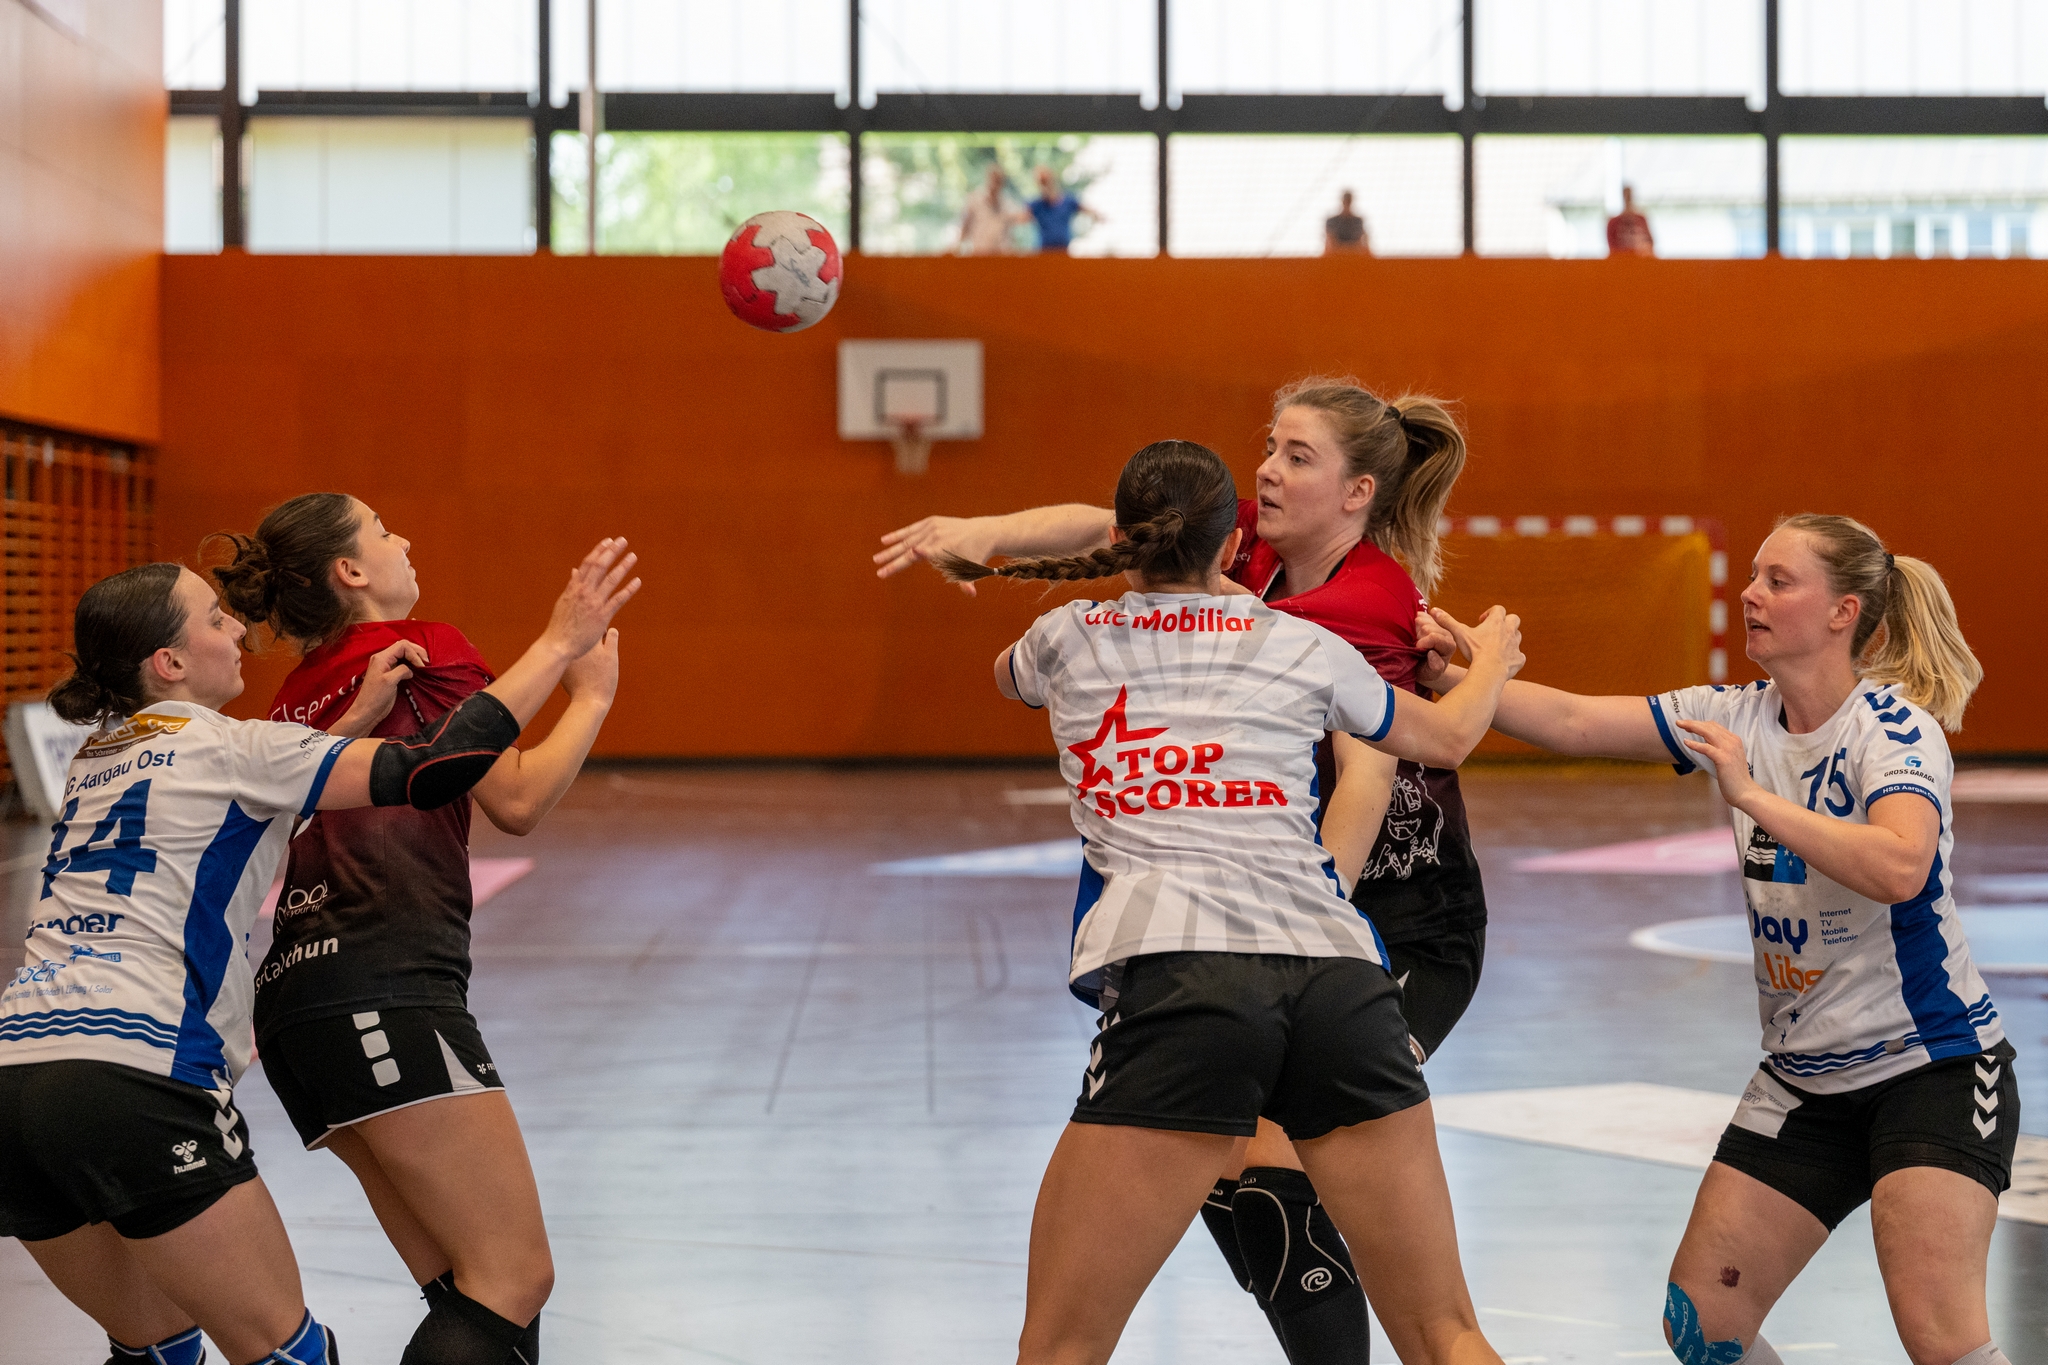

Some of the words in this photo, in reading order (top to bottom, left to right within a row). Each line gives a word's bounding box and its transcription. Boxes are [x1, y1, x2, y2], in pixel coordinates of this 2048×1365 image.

[1132, 606, 1255, 632] Mobiliar
[75, 760, 133, 792] Aargau
[137, 749, 176, 770] Ost
[1116, 742, 1225, 782] TOP
[1883, 768, 1909, 778] GROSS
[1800, 747, 1856, 818] 15
[1882, 785, 1900, 794] HSG
[1094, 779, 1289, 819] SCORER
[40, 778, 158, 902] 14
[1819, 907, 1852, 918] Internet
[1752, 908, 1809, 955] ay
[1820, 919, 1832, 927] TV
[1821, 926, 1849, 937] Mobile
[1822, 933, 1859, 946] Telefonie
[94, 984, 113, 994] Solar
[173, 1156, 207, 1174] hummel
